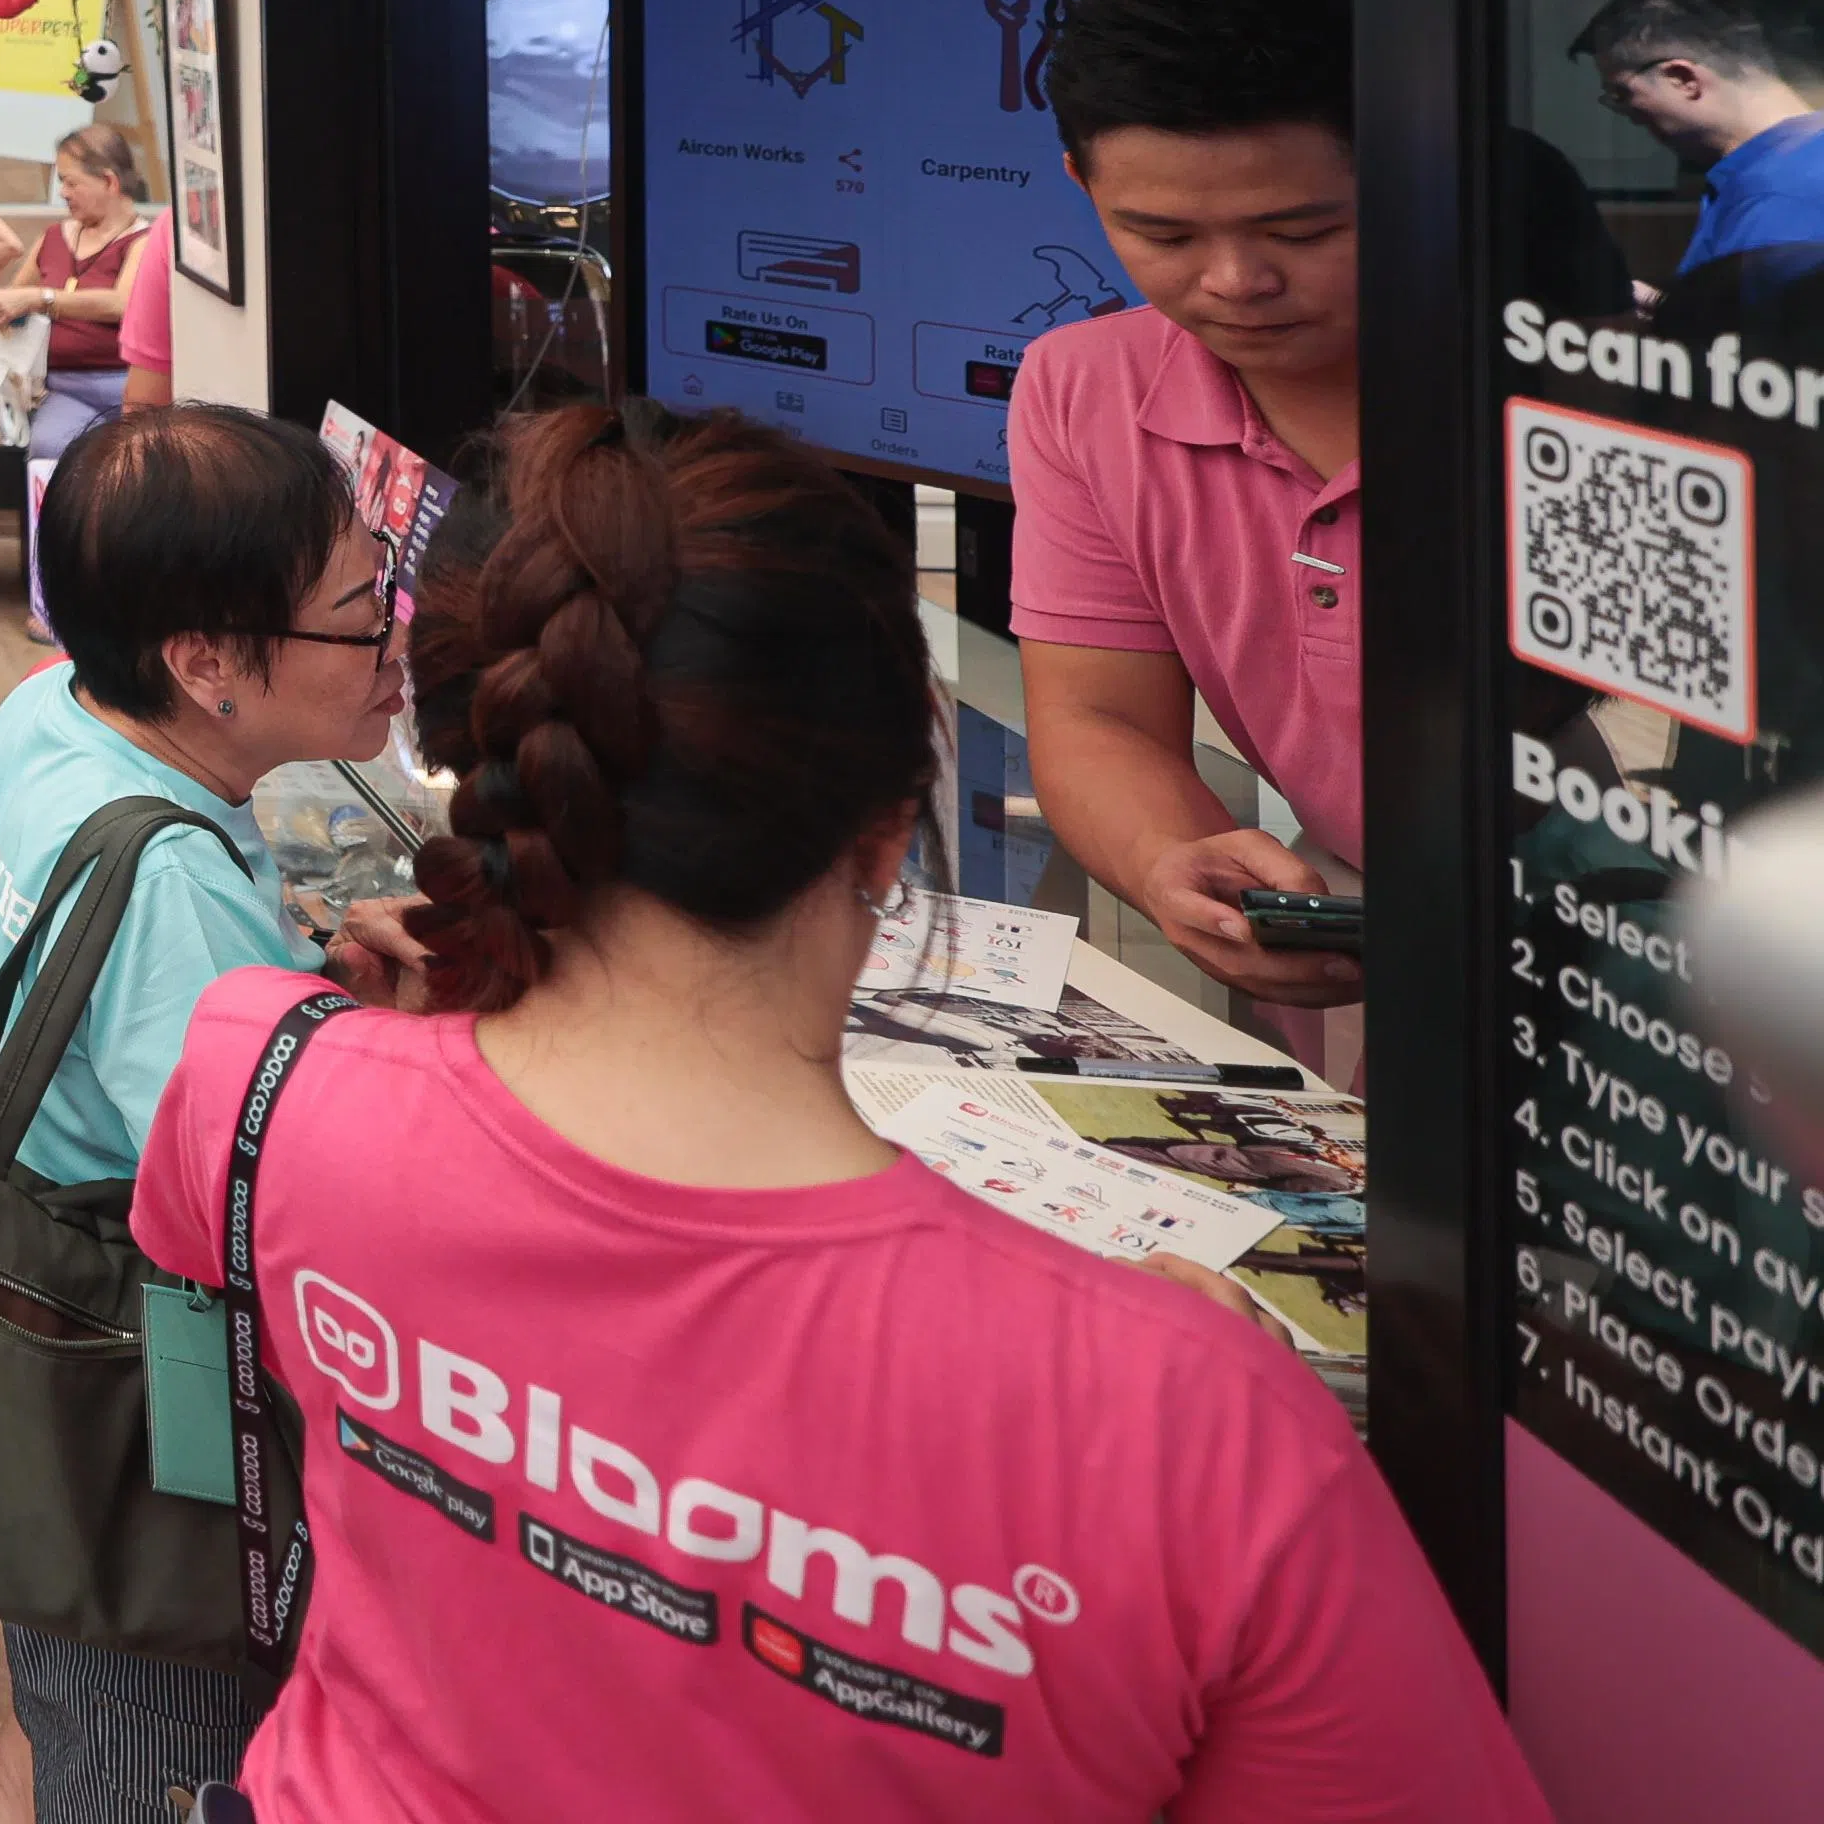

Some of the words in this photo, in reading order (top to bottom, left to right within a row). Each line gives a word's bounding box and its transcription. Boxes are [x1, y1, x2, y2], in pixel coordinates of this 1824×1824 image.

[677, 137, 739, 159] Aircon
[742, 143, 806, 166] Works
[920, 158, 1032, 188] Carpentry
[721, 306, 757, 323] Rate
[761, 312, 781, 327] Us
[786, 315, 809, 330] On
[739, 337, 789, 360] Google
[790, 345, 820, 366] Play
[984, 344, 1025, 362] Rate
[1503, 298, 1693, 400] Scan
[1706, 332, 1824, 429] for
[871, 438, 919, 459] Orders
[1509, 857, 1534, 905] 1.
[1554, 881, 1693, 983] Select
[1510, 938, 1545, 989] 2.
[1558, 964, 1735, 1088] Choose
[1511, 1015, 1548, 1066] 3.
[1558, 1039, 1666, 1138] Type
[1679, 1106, 1789, 1208] your
[1514, 1098, 1550, 1147] 4.
[1560, 1123, 1670, 1224] Click
[1679, 1199, 1741, 1268] on
[1515, 1169, 1550, 1222] 5.
[1562, 1200, 1698, 1325] Select
[1516, 1249, 1550, 1306] 6.
[1562, 1280, 1685, 1396] Place
[1517, 1322, 1550, 1381] 7.
[1563, 1358, 1724, 1508] Instant
[374, 1447, 445, 1500] Google
[446, 1492, 490, 1531] play
[563, 1557, 626, 1604] App
[630, 1585, 710, 1638] Store
[813, 1646, 889, 1686] EXPLORE
[813, 1669, 992, 1750] AppGallery
